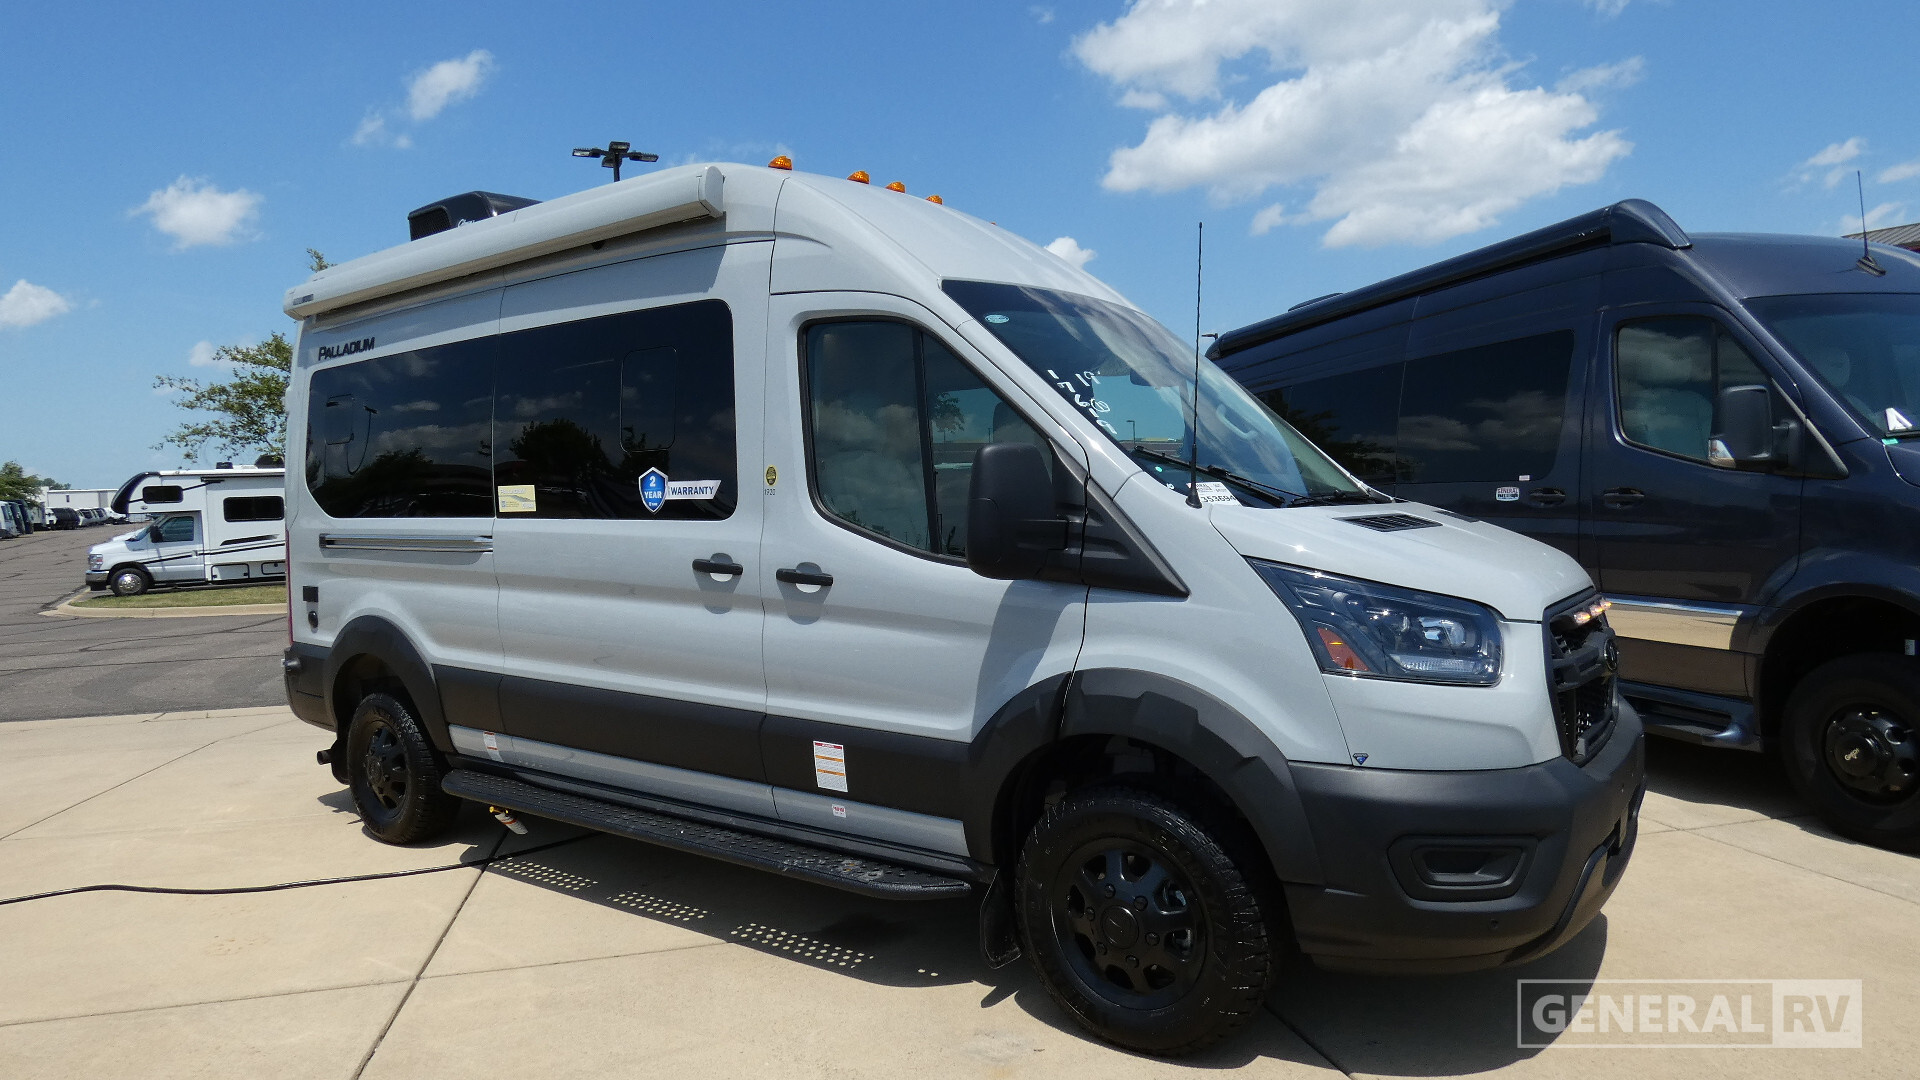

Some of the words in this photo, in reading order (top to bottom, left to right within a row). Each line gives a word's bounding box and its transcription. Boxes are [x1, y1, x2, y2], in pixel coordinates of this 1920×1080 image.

[318, 337, 375, 361] PALLADIUM
[649, 475, 656, 487] 2
[644, 490, 662, 499] YEAR
[670, 486, 714, 496] WARRANTY
